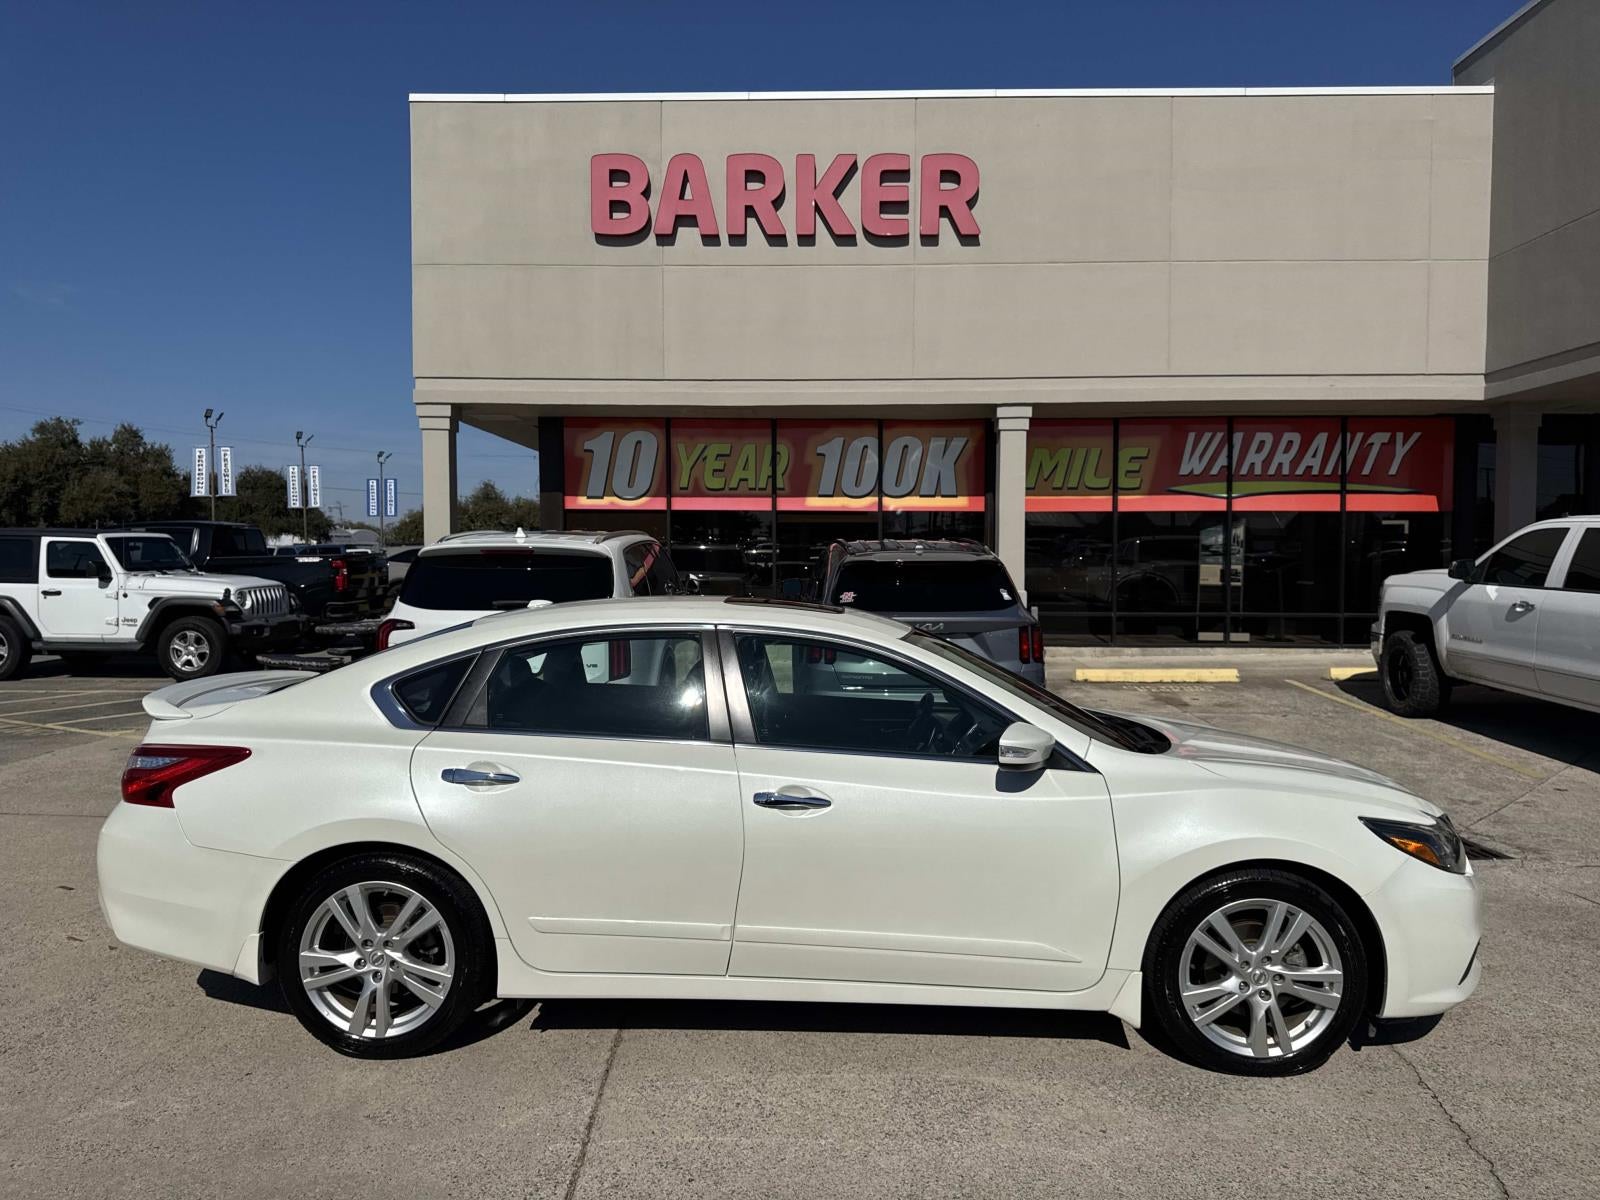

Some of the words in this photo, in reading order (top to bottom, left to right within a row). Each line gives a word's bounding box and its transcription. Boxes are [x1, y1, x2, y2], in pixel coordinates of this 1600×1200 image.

[591, 152, 981, 243] BARKER
[583, 430, 660, 500] 10
[675, 443, 790, 491] YEAR
[815, 436, 969, 498] 100K
[1025, 447, 1149, 490] MILE
[1178, 431, 1422, 477] WARRANTY
